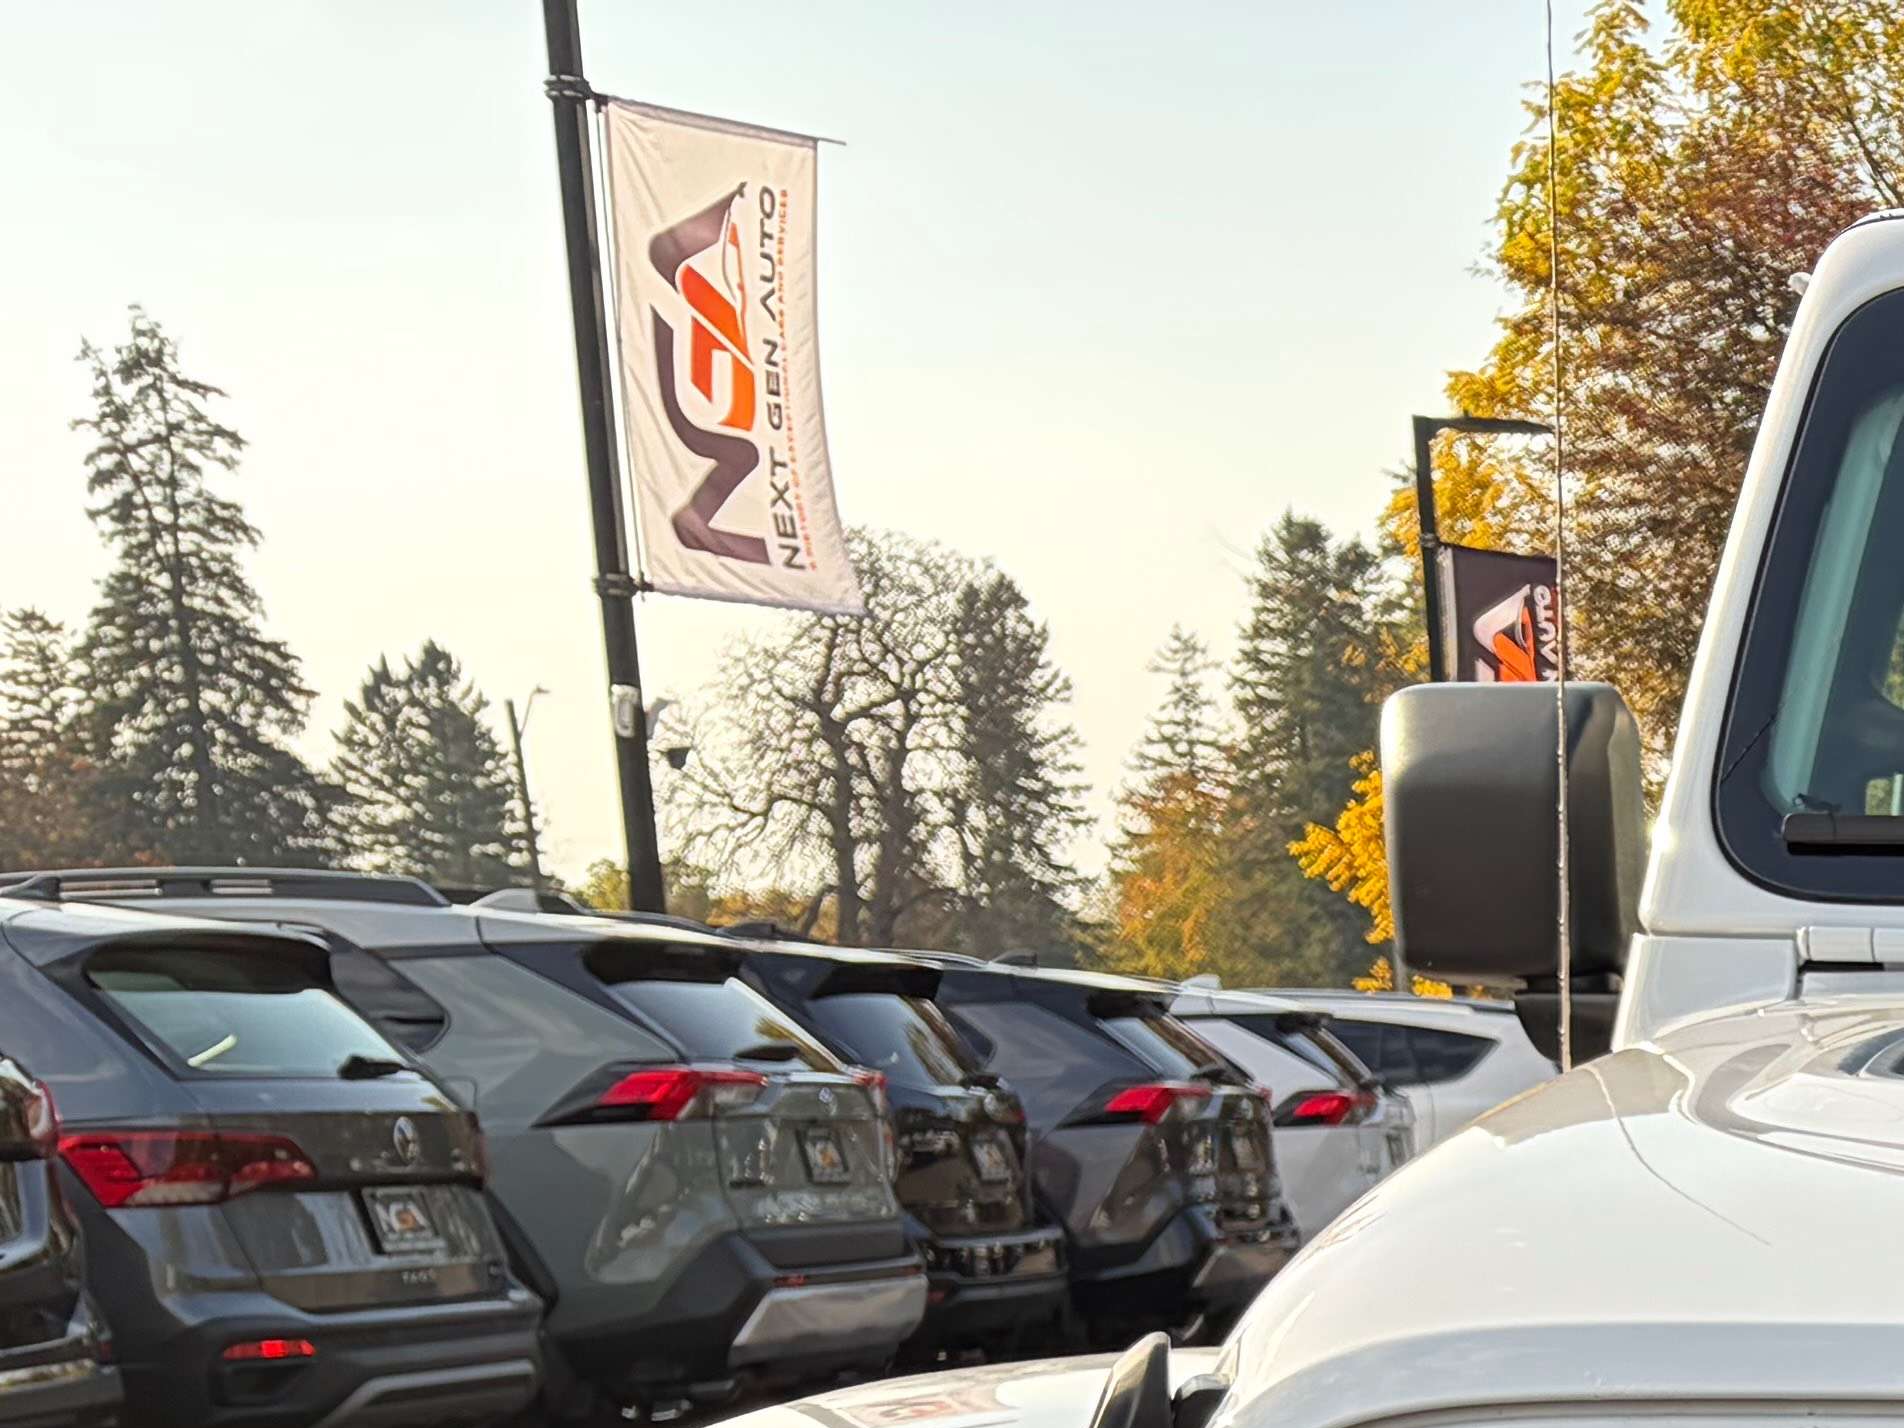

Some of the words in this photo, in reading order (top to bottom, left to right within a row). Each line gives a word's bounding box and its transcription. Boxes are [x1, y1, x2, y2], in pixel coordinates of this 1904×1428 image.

[759, 186, 776, 322] AUTO
[763, 338, 783, 431] GEN
[769, 446, 806, 571] NEXT
